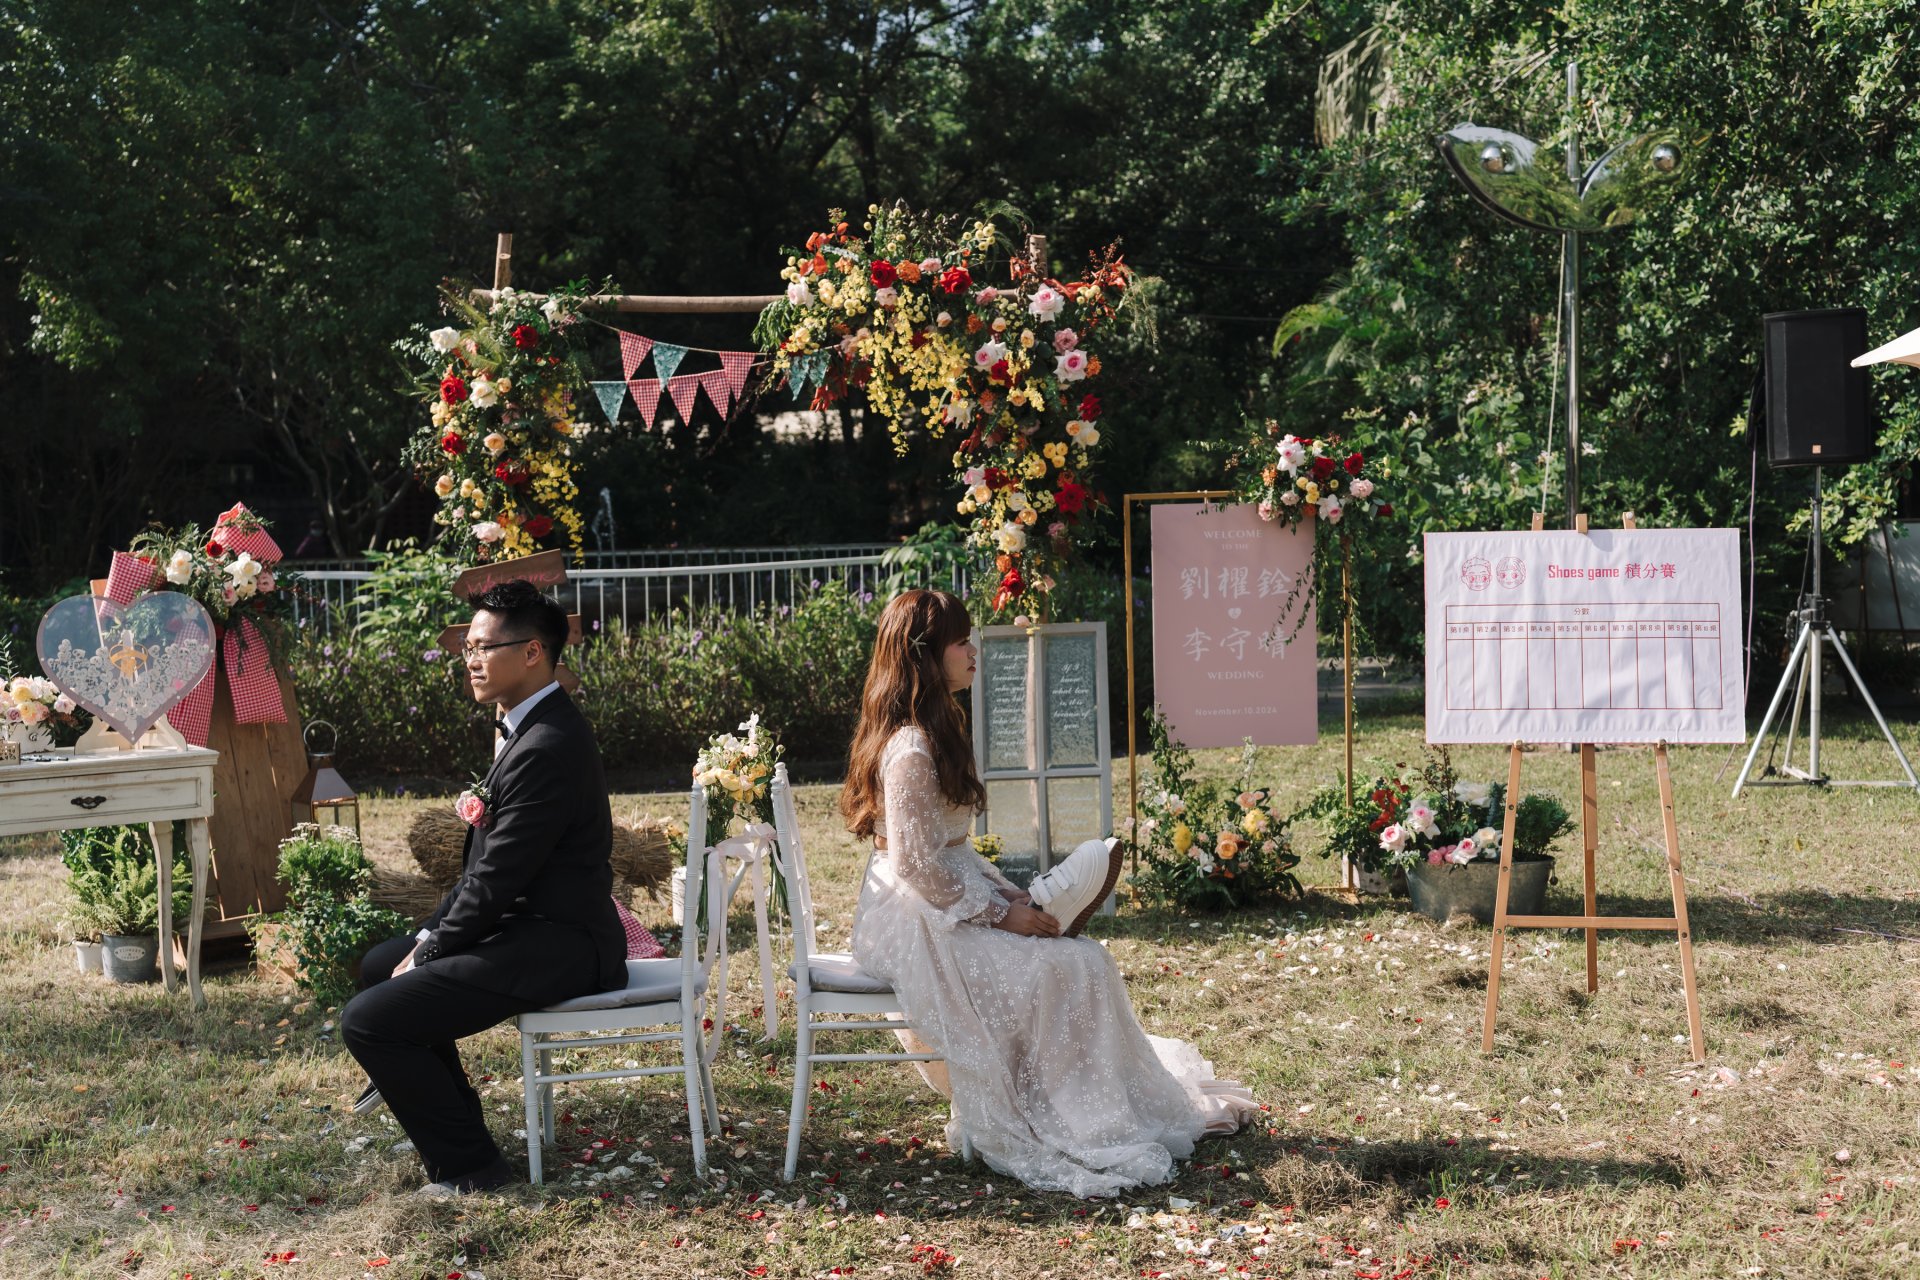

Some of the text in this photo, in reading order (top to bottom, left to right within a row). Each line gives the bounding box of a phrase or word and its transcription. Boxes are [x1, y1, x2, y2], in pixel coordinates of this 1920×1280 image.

[1203, 529, 1264, 539] WELCOME
[1548, 562, 1677, 581] Shoes game 積分賽
[1182, 627, 1291, 662] 李守晴
[998, 652, 1014, 660] love
[1061, 663, 1071, 673] If
[1207, 670, 1264, 680] WEDDING
[1052, 687, 1072, 695] what
[1195, 706, 1278, 716] November.10.2024
